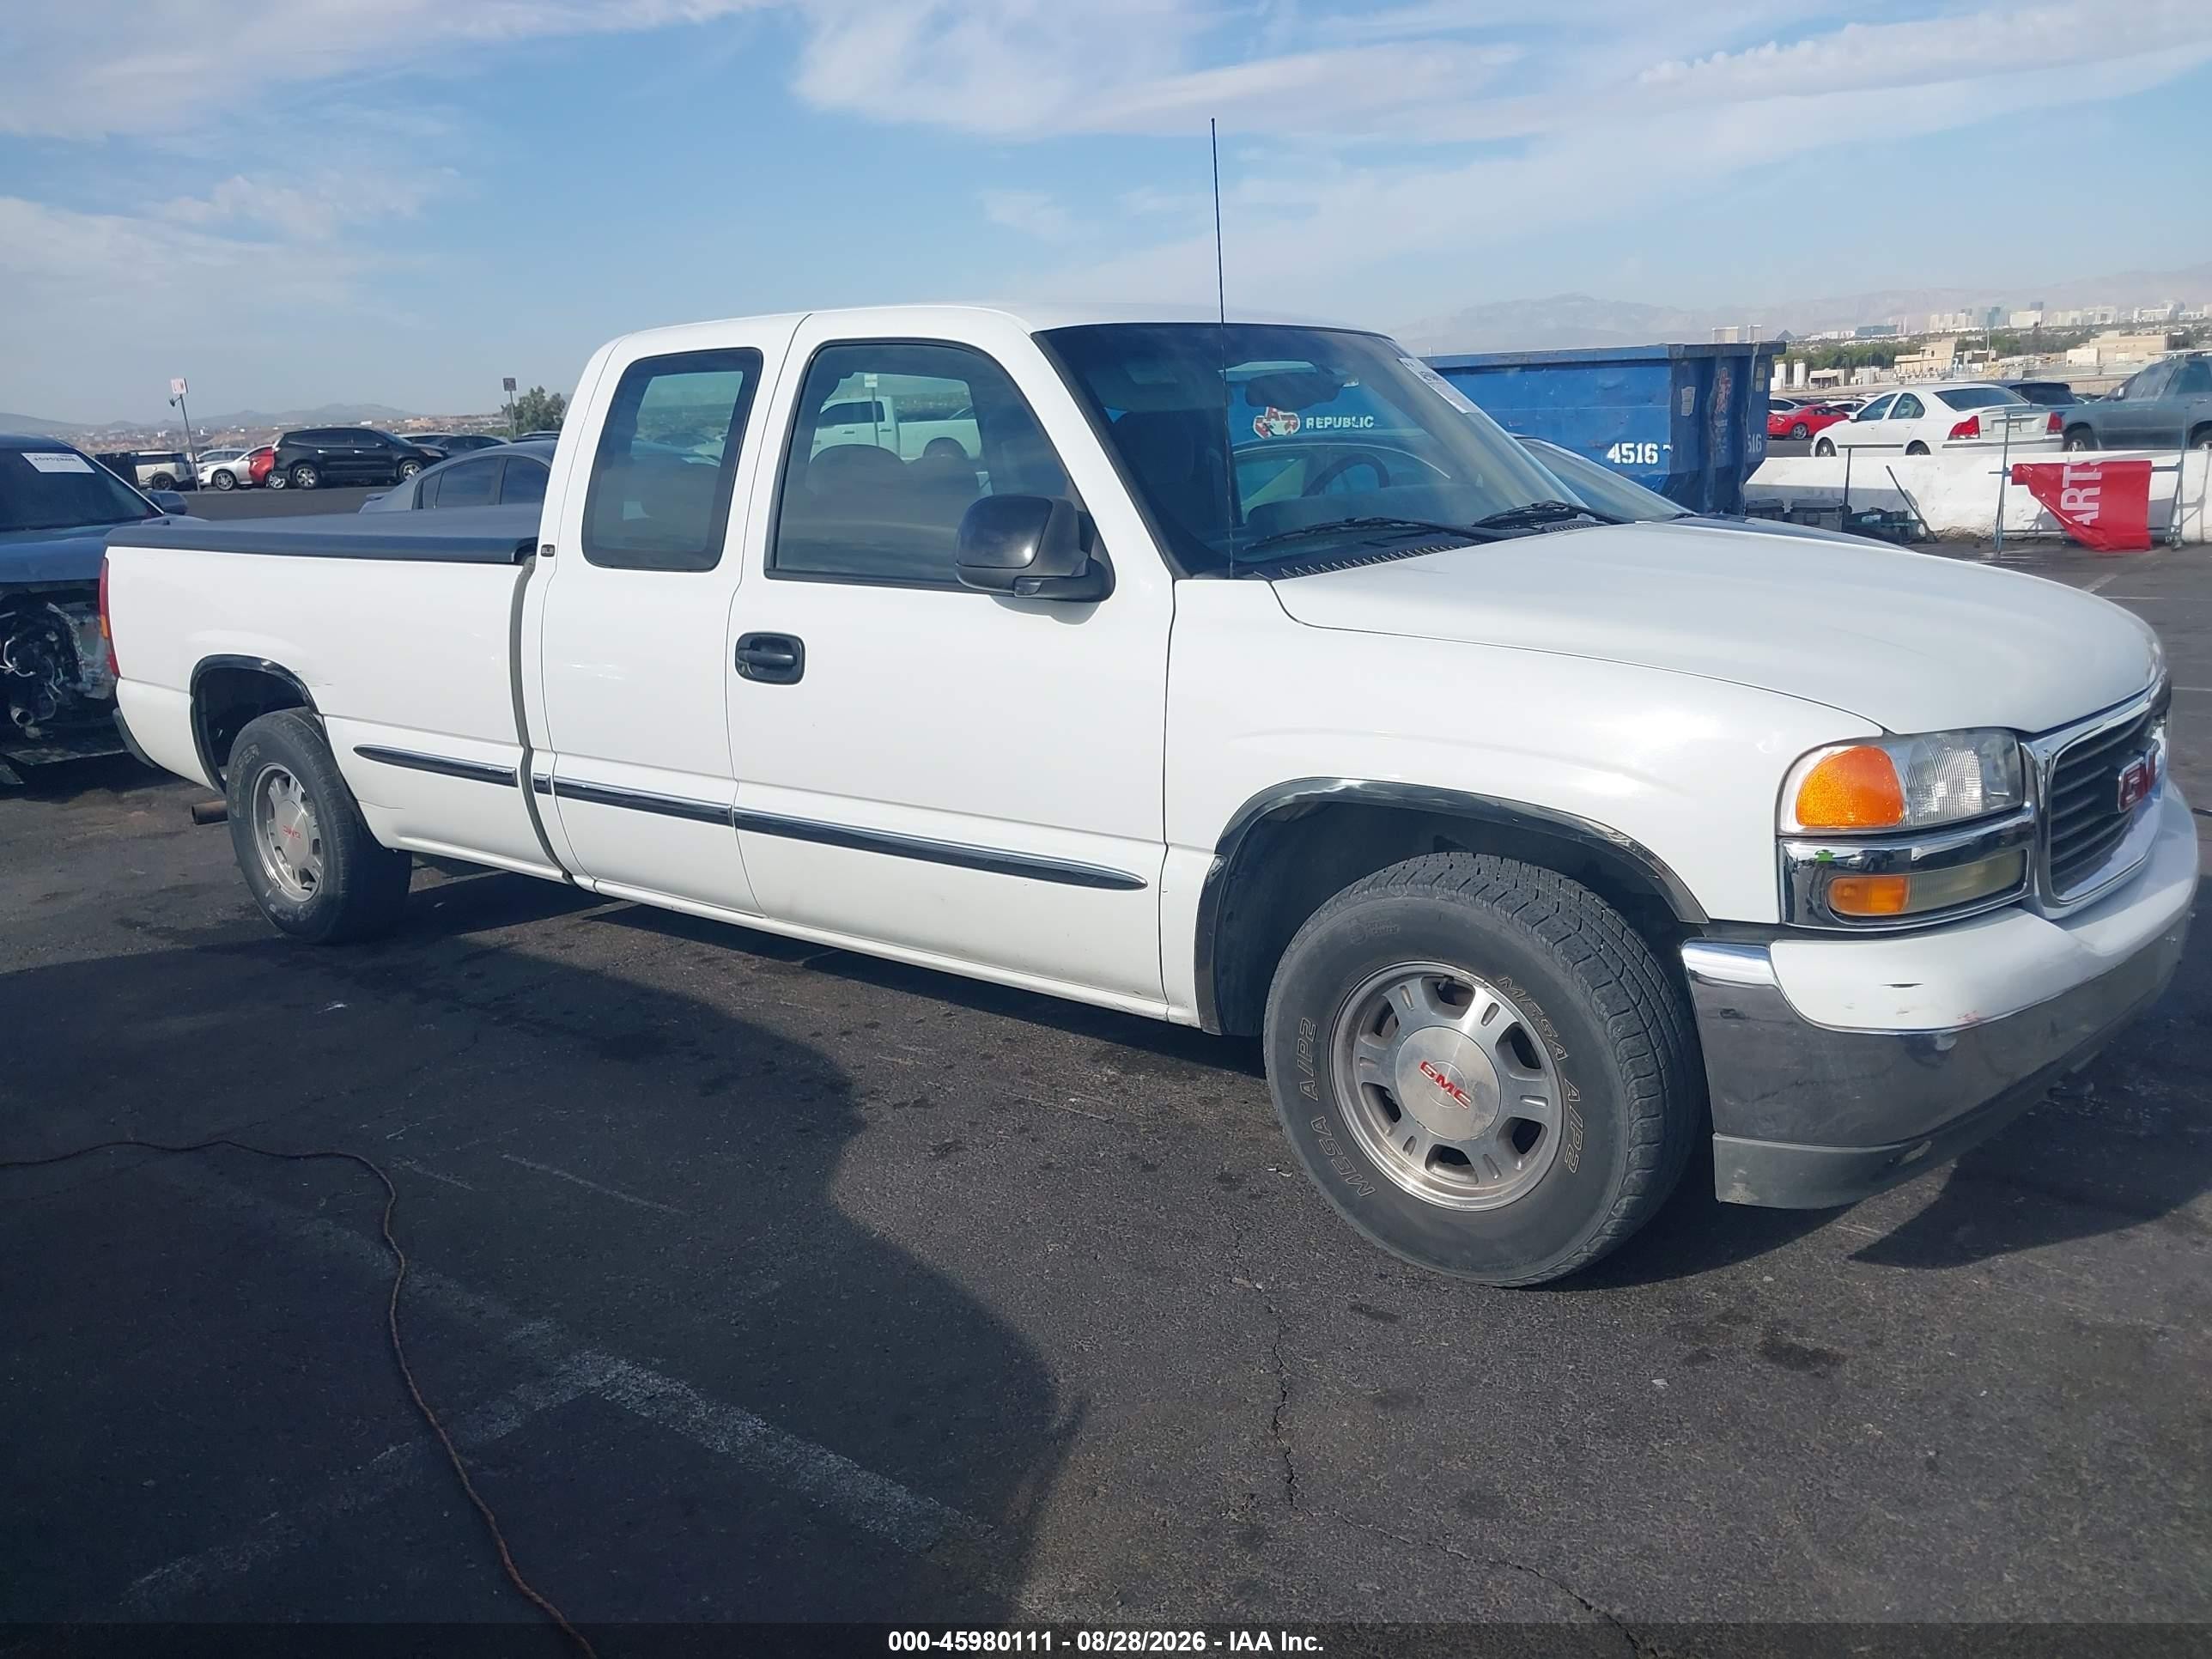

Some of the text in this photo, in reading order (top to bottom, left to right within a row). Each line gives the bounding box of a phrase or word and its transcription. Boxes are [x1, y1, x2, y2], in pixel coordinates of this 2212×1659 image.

[1305, 416, 1374, 429] REPUBLIC
[1607, 442, 1659, 465] 4516
[1419, 1060, 1472, 1109] GMC
[1310, 1115, 1376, 1197] MESA
